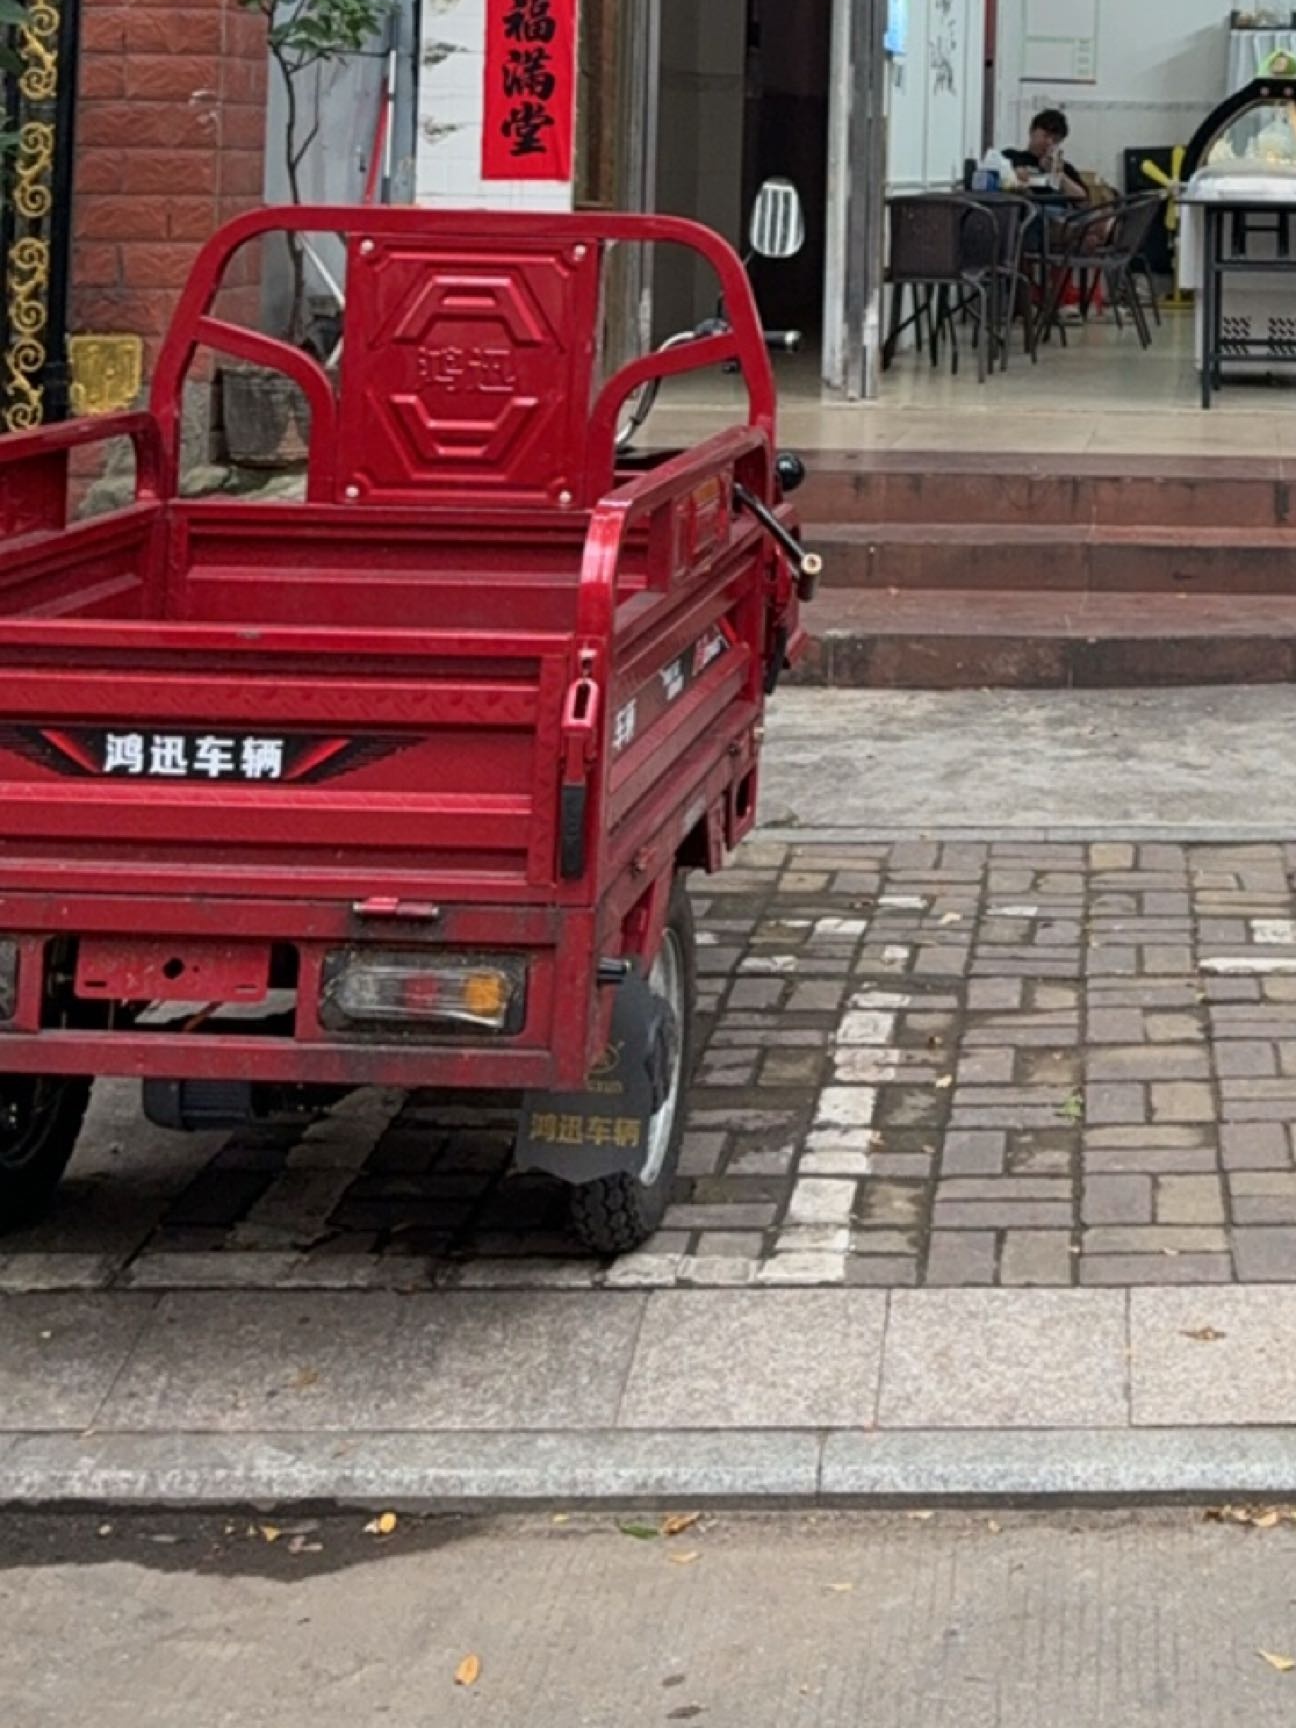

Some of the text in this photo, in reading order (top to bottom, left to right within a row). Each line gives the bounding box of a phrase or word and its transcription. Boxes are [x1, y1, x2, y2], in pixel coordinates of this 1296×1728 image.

[103, 733, 285, 779] 鸿迅车辆
[528, 1112, 642, 1149] 鸿迅车辆
